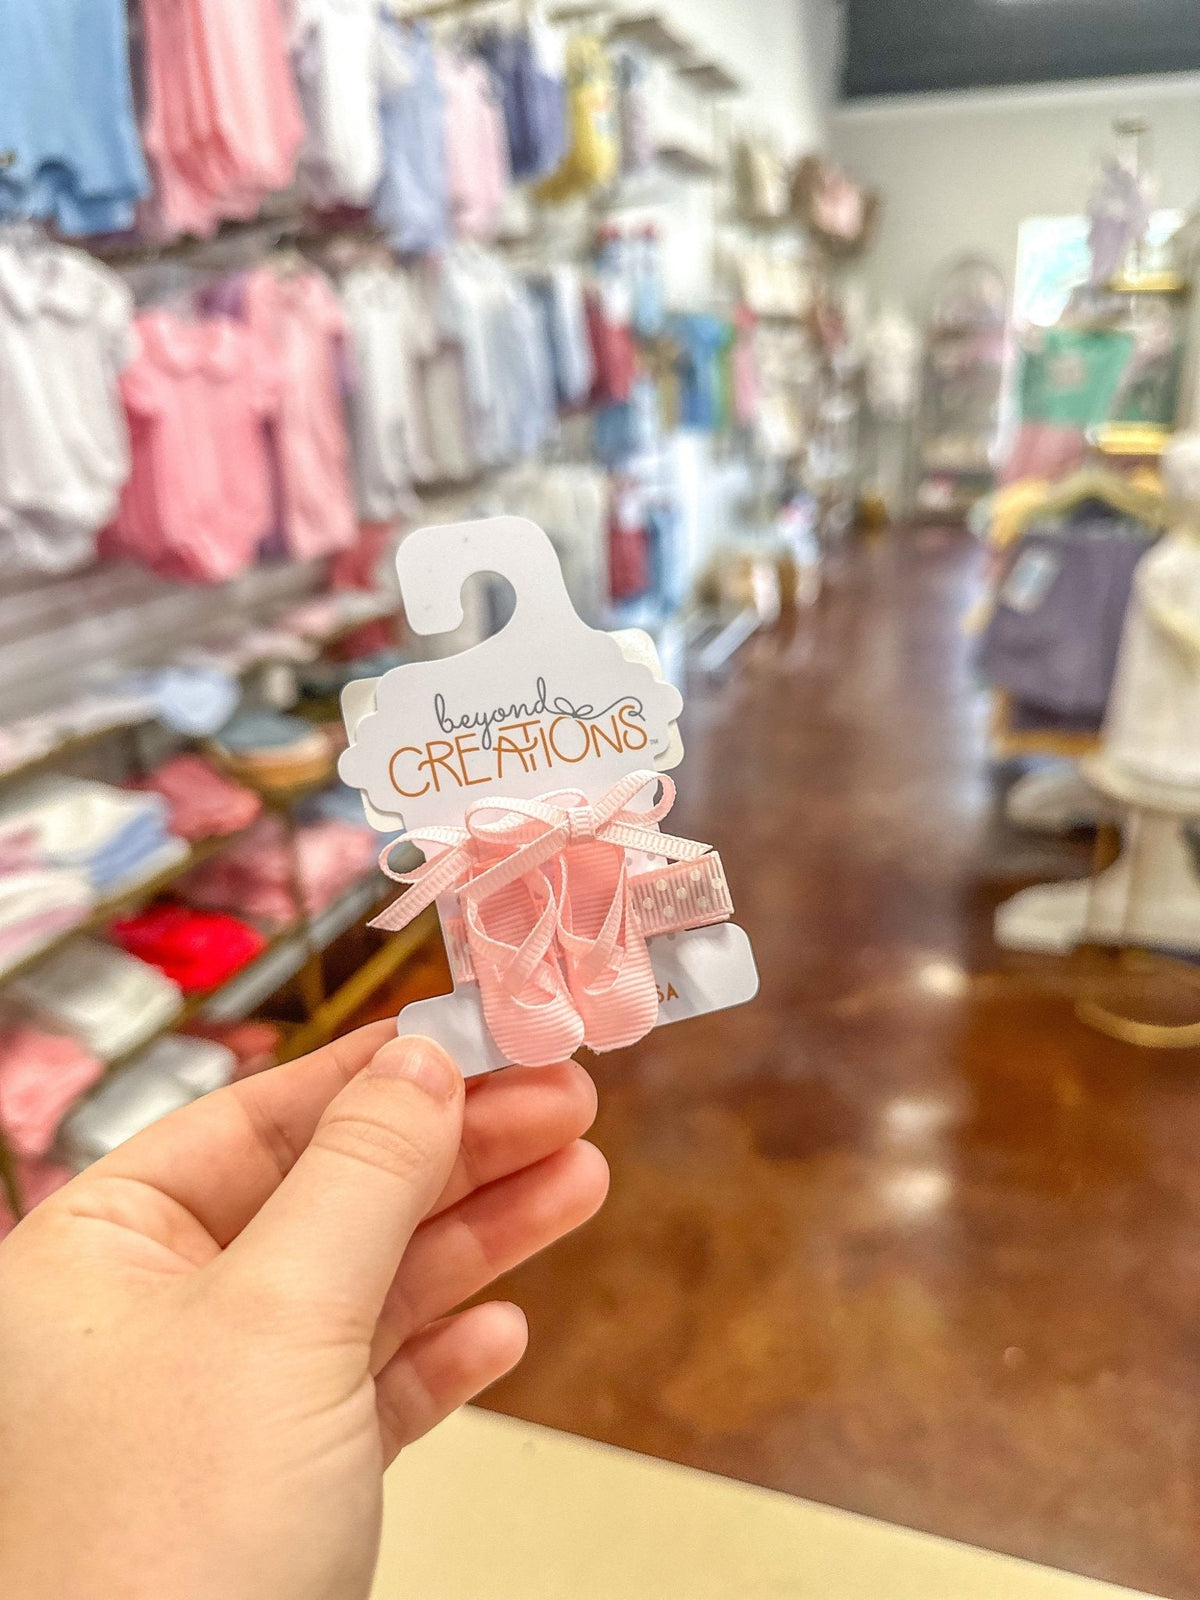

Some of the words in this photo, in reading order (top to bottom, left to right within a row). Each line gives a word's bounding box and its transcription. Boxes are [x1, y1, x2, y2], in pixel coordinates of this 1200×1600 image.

[434, 676, 558, 750] beyond
[388, 704, 648, 798] CREATIONS
[655, 981, 679, 1003] SA
